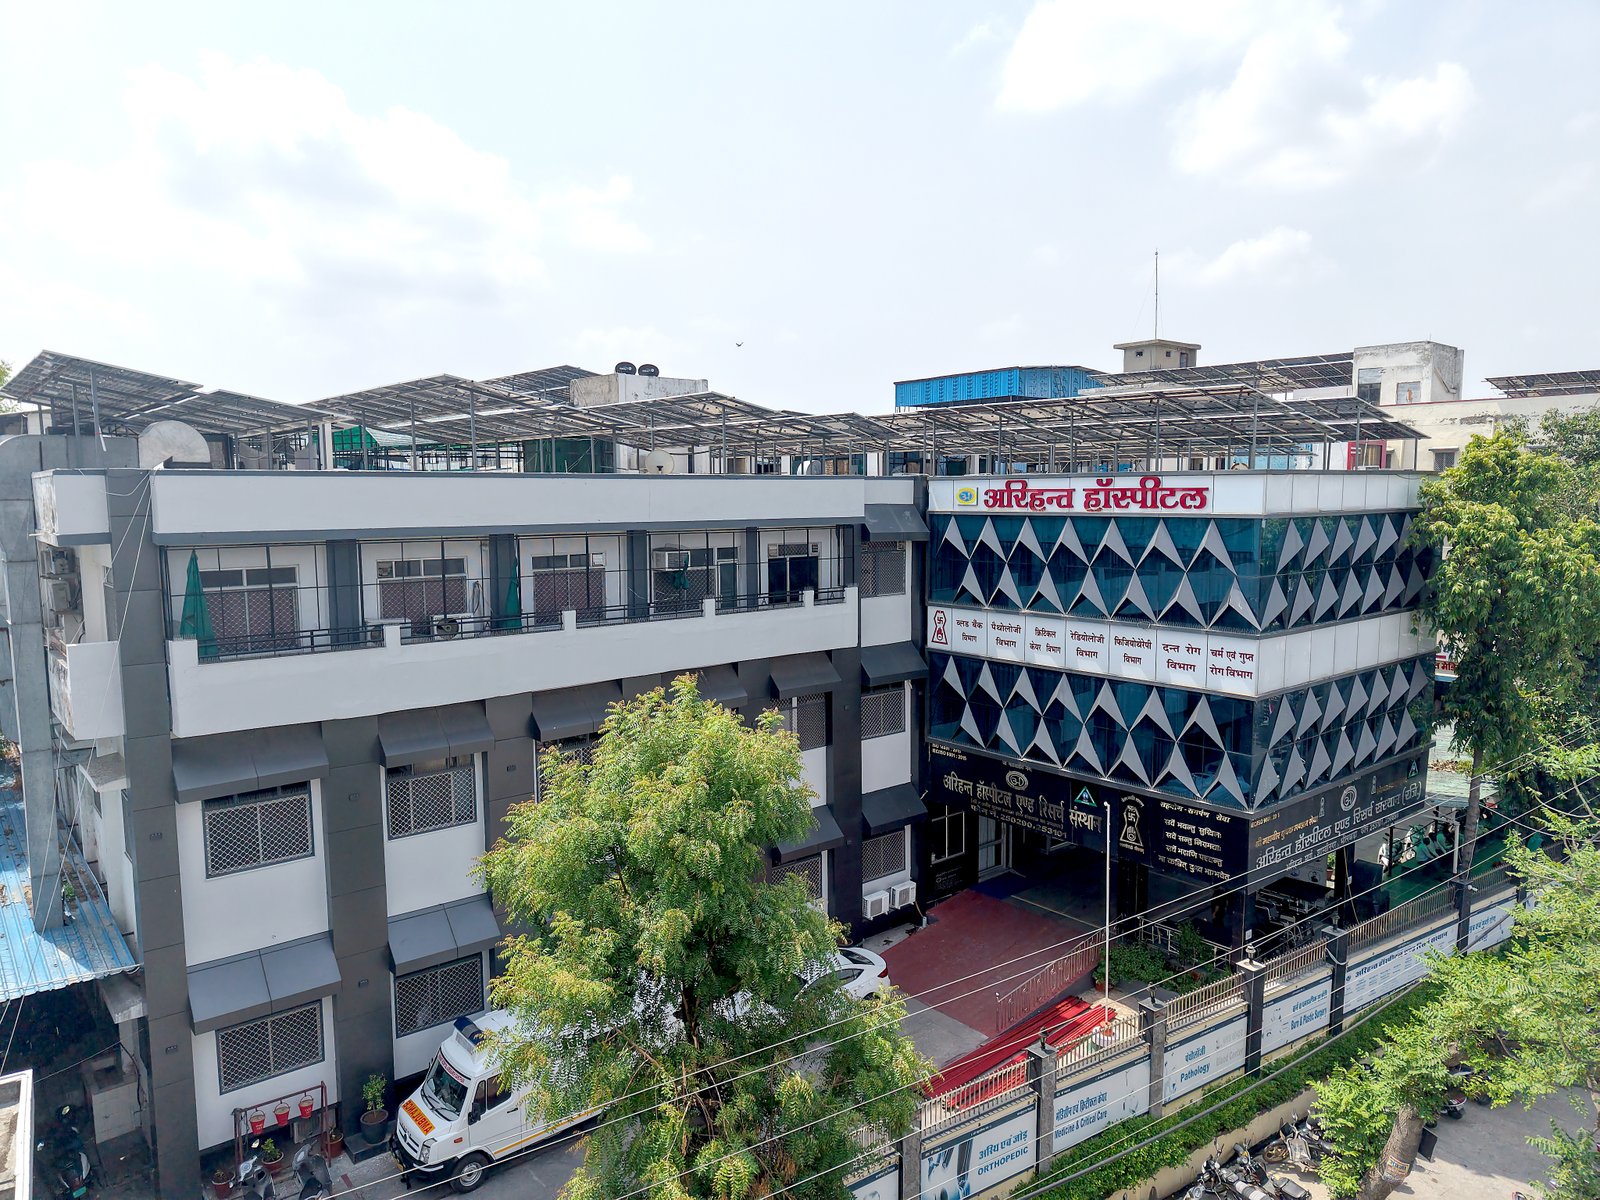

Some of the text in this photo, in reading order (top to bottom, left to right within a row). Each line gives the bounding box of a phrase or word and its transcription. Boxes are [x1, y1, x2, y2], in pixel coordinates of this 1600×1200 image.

[983, 476, 1209, 512] अरिहन्त हॉस्पीटल
[995, 636, 1017, 648] विभाग
[1162, 643, 1201, 656] दन्त रोग
[1076, 647, 1099, 659] विभाग
[1123, 653, 1142, 665] विभाग
[1210, 647, 1224, 658] चर्म
[1239, 652, 1254, 665] गुप्त
[1166, 658, 1197, 673] विभाग
[1209, 664, 1253, 680] रोग विभाग
[943, 771, 973, 797] अरिहन्त
[1039, 795, 1064, 823] रिसर्च
[1069, 805, 1102, 833] संस्थान
[1255, 842, 1293, 869] अरिहन्त
[1353, 800, 1375, 825] रिसर्च
[1375, 797, 1401, 814] संस्थान
[1355, 963, 1378, 978] अरिहन्त
[1180, 1063, 1210, 1082] Pathology
[1054, 1123, 1075, 1139] Medicine
[1080, 1113, 1097, 1128] Critical
[1097, 1110, 1108, 1121] Care
[1000, 1134, 1012, 1149] एवं
[977, 1146, 1029, 1176] ORTHOPEDIC
